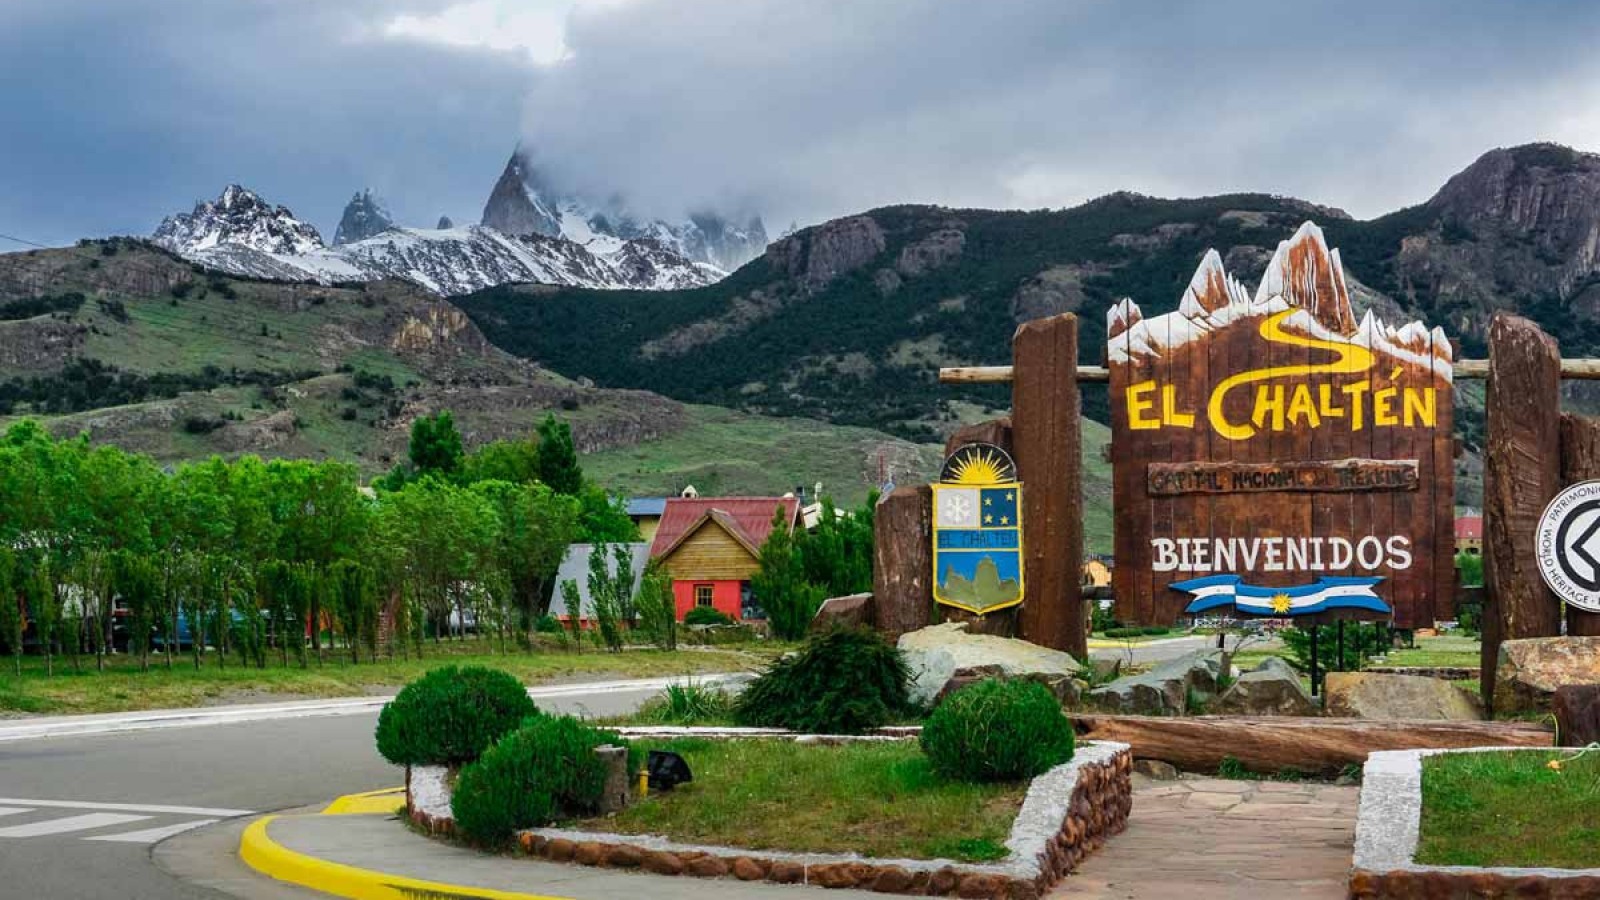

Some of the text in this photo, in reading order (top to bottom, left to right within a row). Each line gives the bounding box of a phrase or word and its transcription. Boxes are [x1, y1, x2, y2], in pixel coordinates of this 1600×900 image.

[1125, 366, 1437, 441] EL CHALTÉN
[1231, 470, 1304, 490] NACIONAL
[1549, 485, 1600, 521] PATRIMONI
[1151, 535, 1413, 572] BIENVENIDOS
[1548, 568, 1589, 604] HERITAGE
